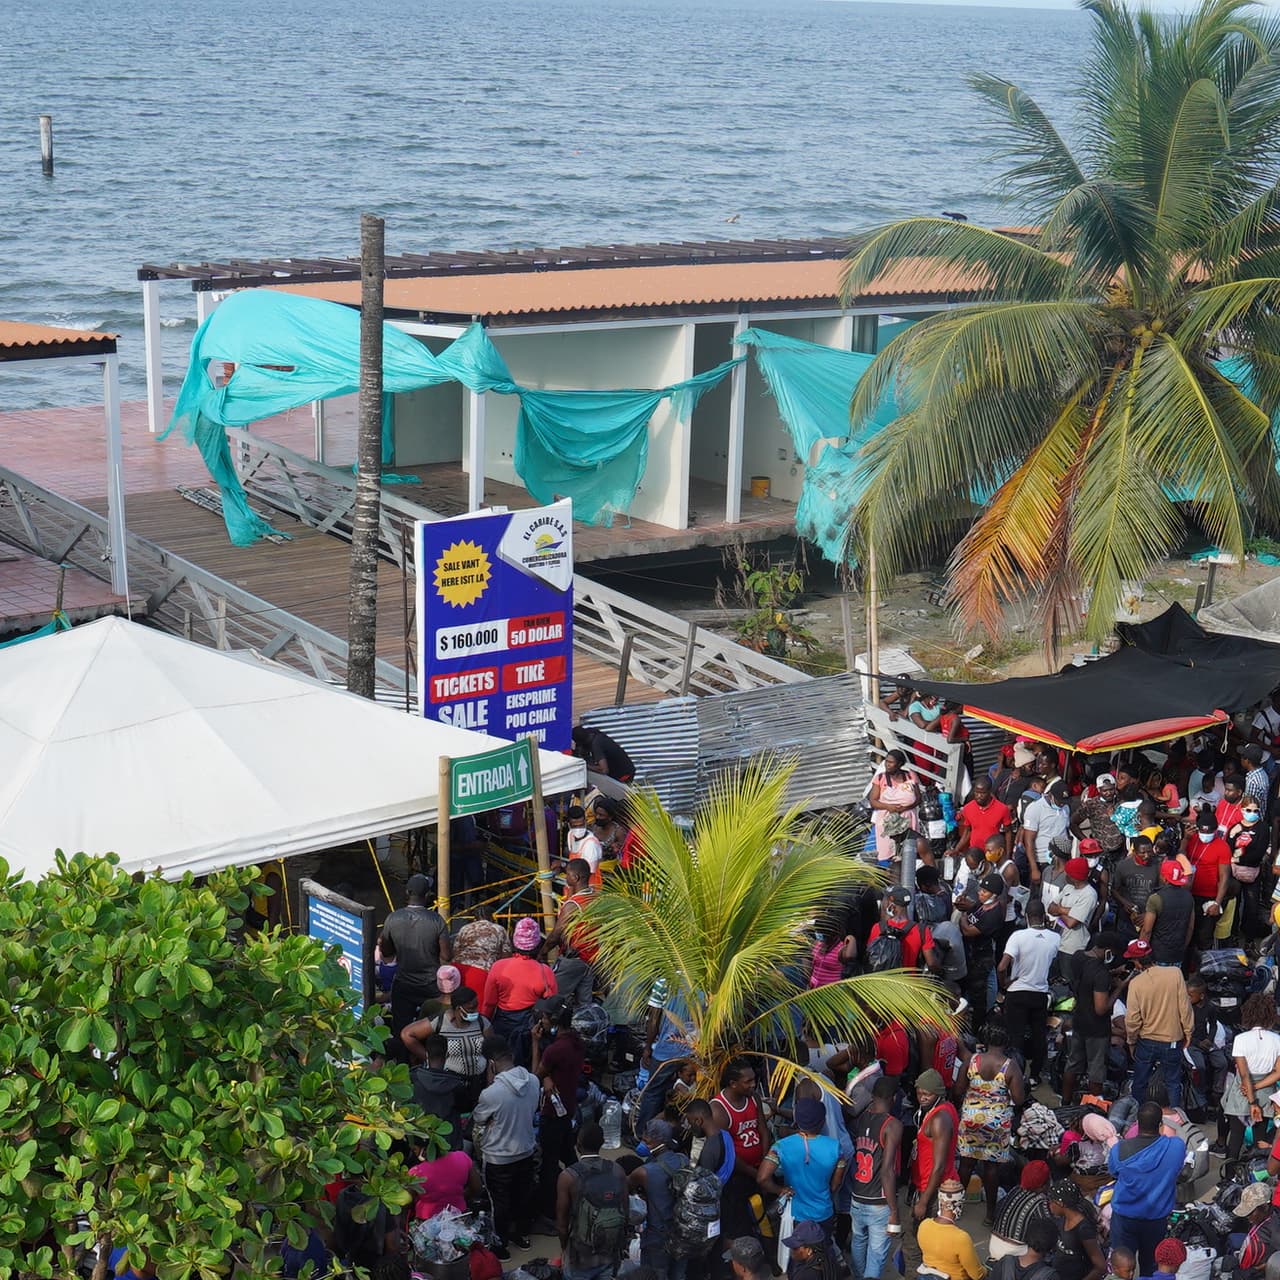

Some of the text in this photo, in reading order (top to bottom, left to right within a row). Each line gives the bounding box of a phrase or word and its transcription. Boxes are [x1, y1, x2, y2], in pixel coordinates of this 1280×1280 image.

[443, 559, 480, 572] SALE VANT
[441, 577, 459, 587] HERE
[440, 628, 498, 652] $ 160.000
[511, 624, 562, 645] 50 DOLAR
[434, 671, 494, 697] TICKETS
[506, 688, 557, 710] EKSPRIME
[438, 699, 489, 729] SALE
[506, 707, 557, 729] POU CHAK
[457, 763, 514, 798] ENTRADA
[739, 1130, 760, 1148] 23
